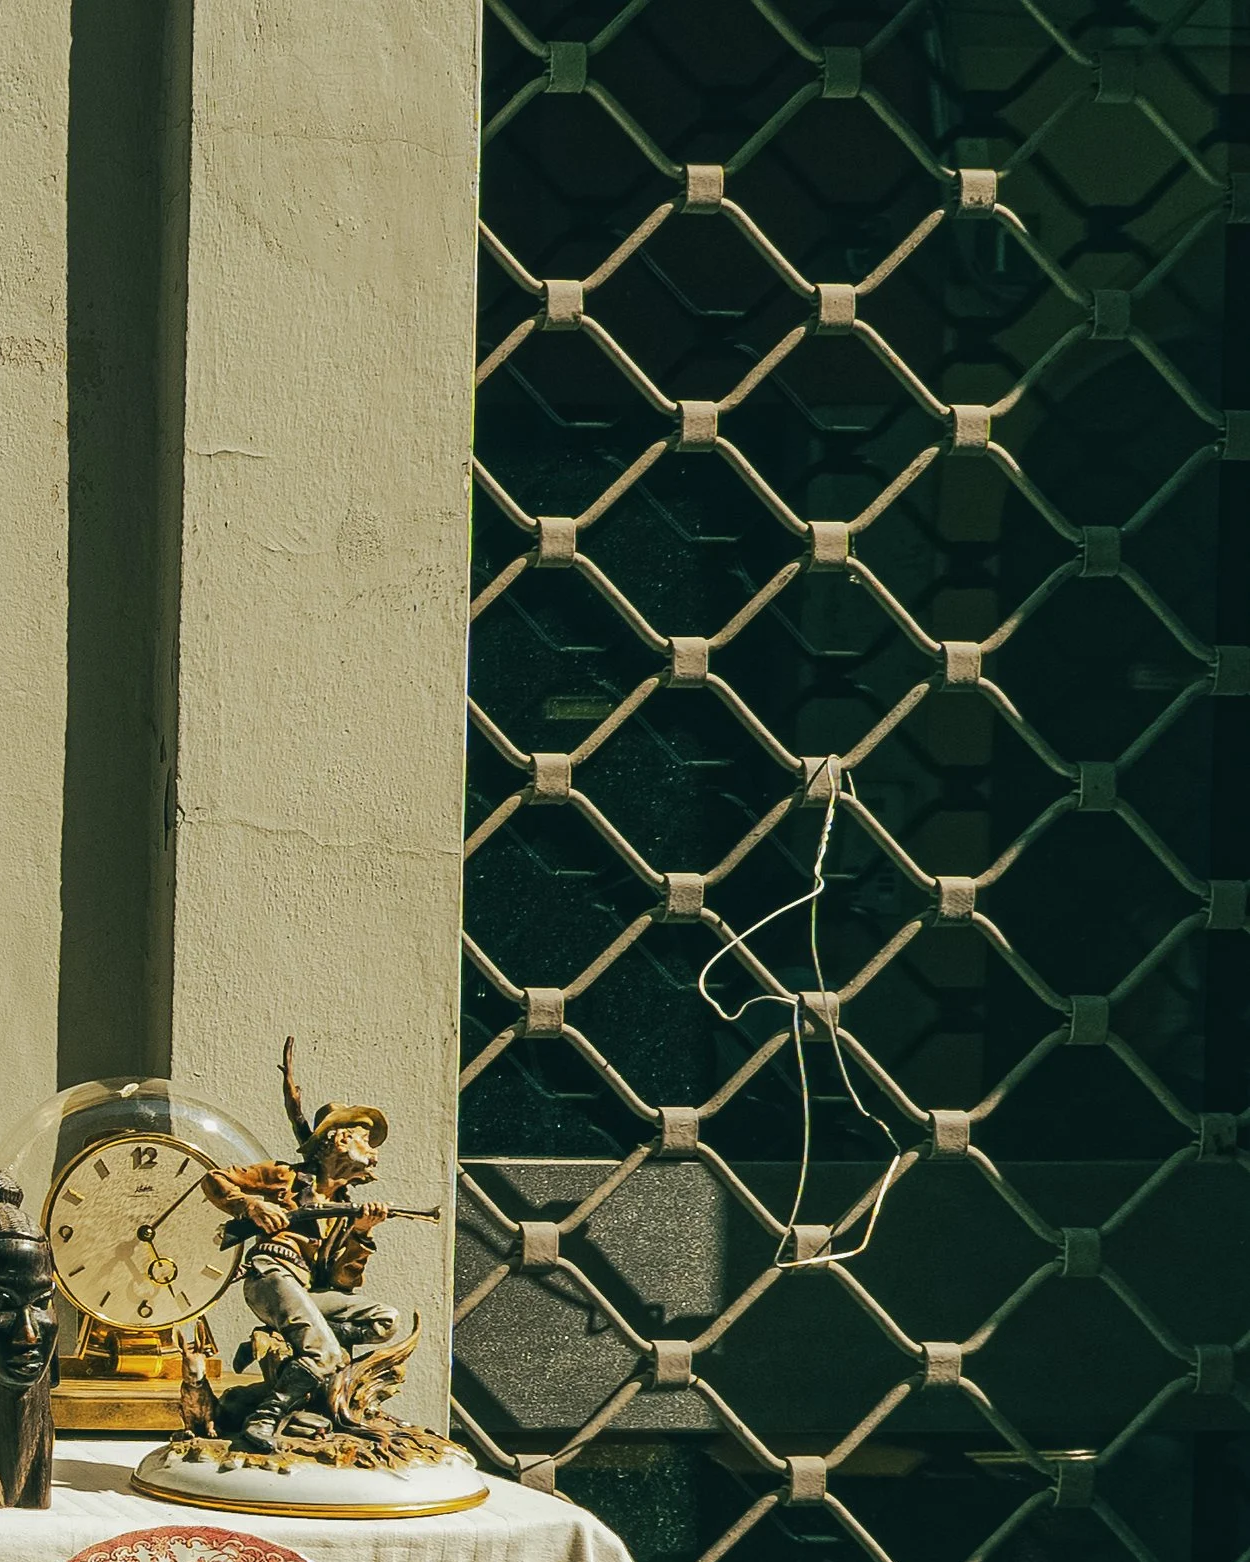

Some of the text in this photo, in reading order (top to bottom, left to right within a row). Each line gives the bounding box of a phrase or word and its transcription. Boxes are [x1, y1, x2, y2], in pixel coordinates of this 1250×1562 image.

[130, 1147, 158, 1170] 12
[58, 1225, 73, 1243] 9
[137, 1300, 152, 1318] 6
